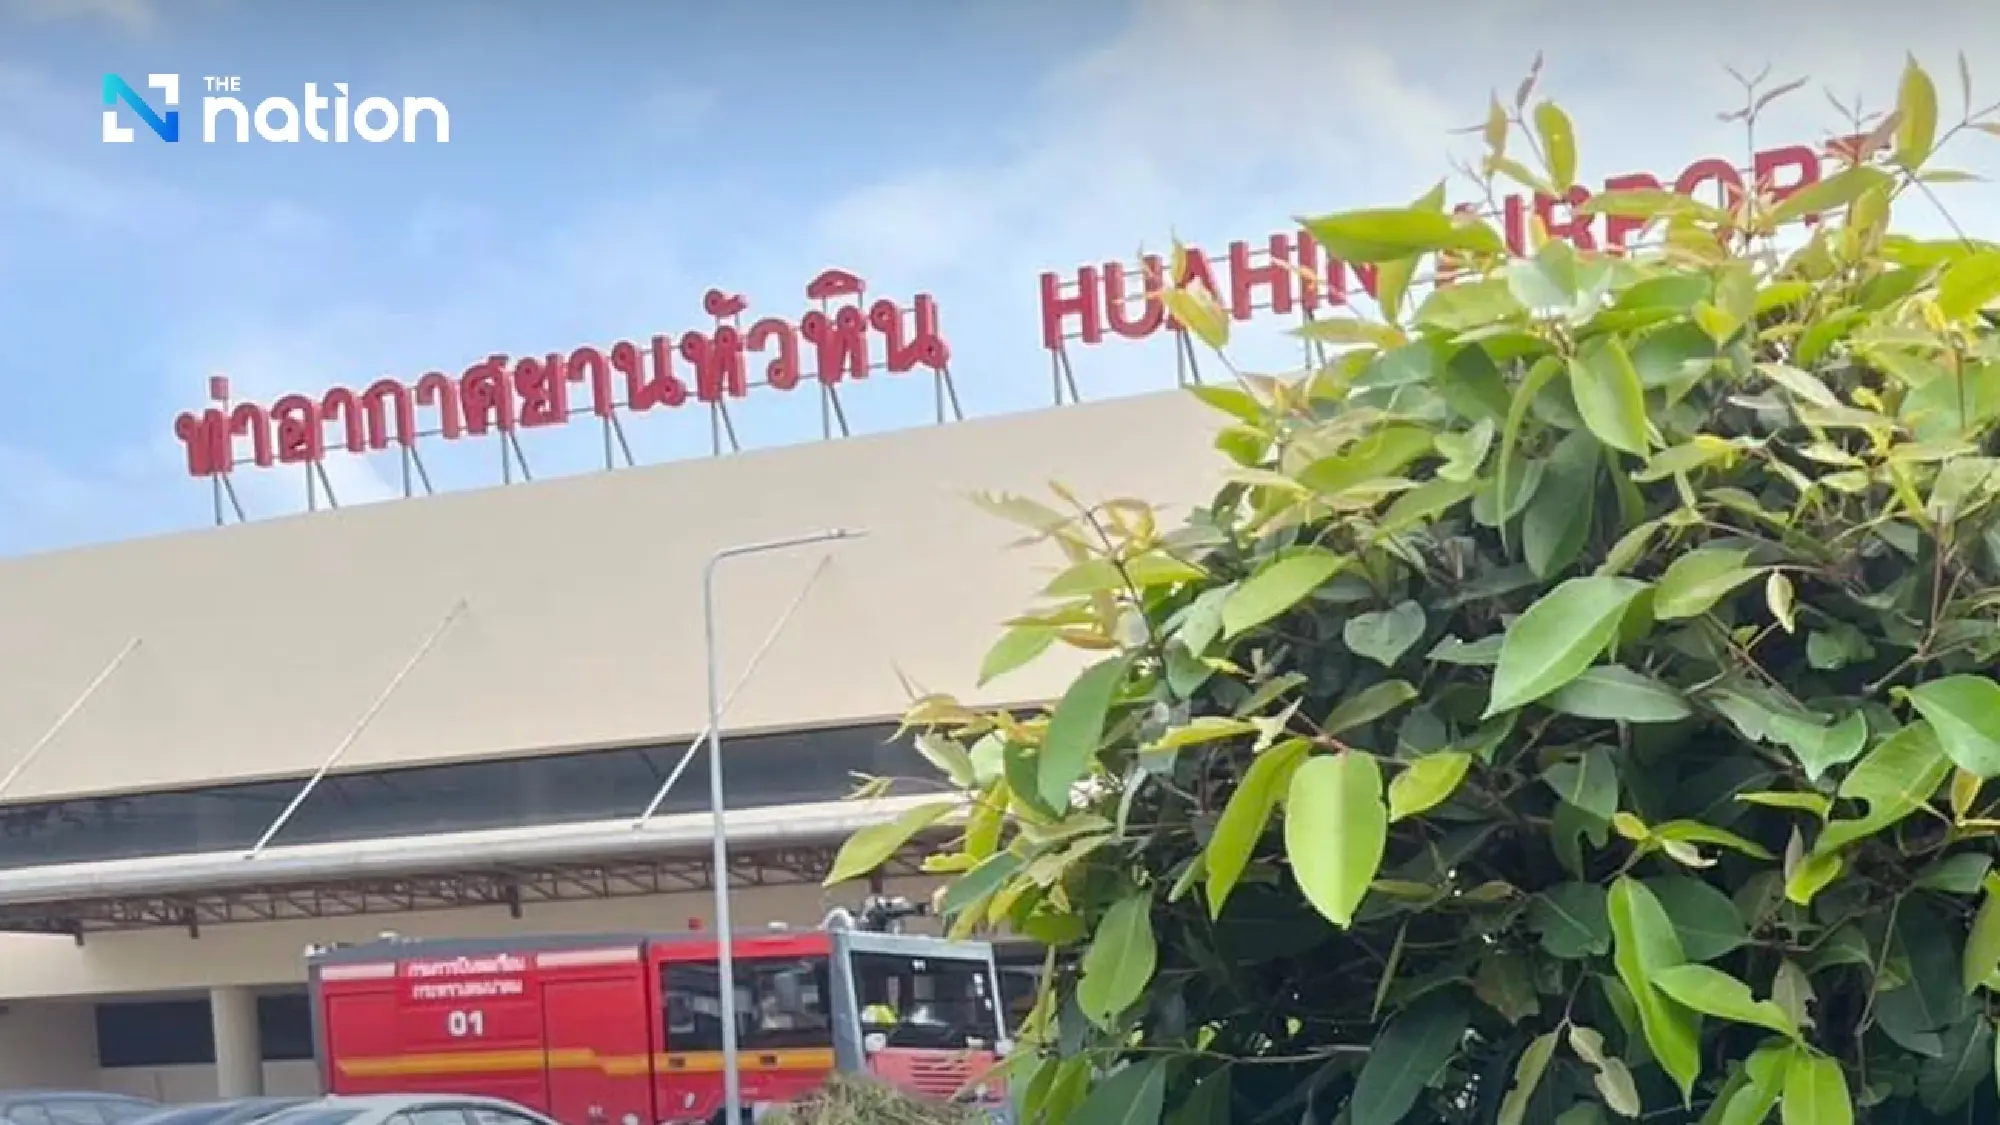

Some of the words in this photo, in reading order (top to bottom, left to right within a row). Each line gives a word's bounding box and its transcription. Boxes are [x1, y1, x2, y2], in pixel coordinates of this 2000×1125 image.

[175, 269, 949, 476] ท่าอากาศยานหัวหิน
[449, 1010, 484, 1037] 01
